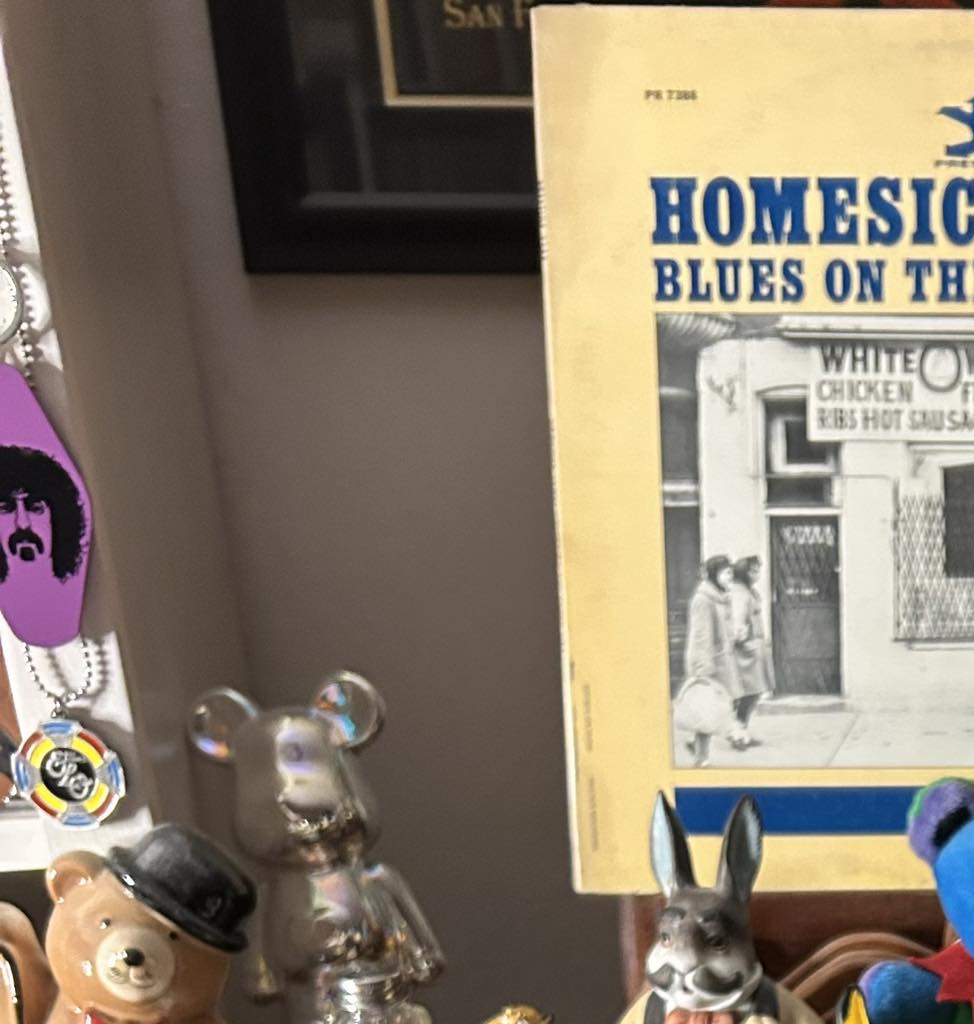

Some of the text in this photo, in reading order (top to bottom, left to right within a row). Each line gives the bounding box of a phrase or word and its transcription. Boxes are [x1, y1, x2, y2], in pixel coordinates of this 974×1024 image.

[653, 258, 805, 303] BLUES
[825, 258, 886, 303] ON
[819, 345, 918, 374] WHITE
[816, 379, 915, 403] CHICKEN
[861, 408, 903, 430] HOT
